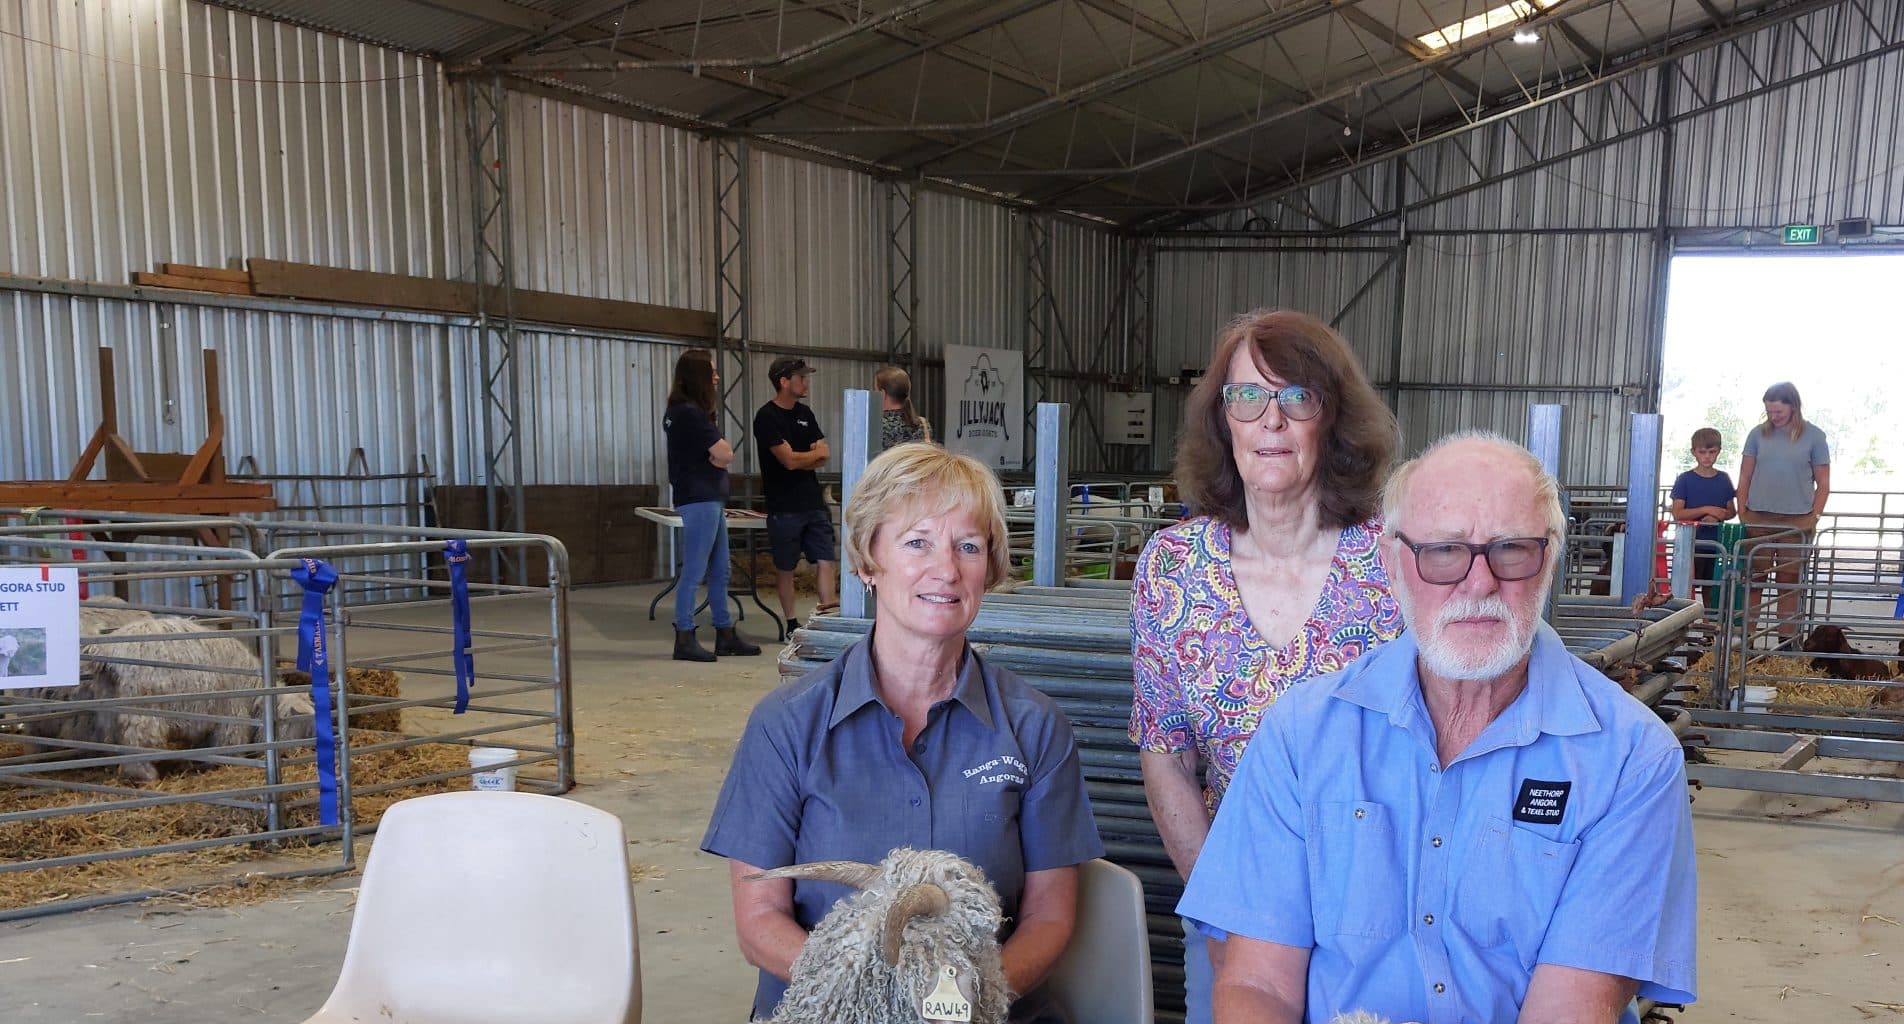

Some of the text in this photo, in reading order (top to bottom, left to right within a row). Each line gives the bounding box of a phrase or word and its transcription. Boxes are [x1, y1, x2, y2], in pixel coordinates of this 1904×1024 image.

[1790, 228, 1812, 241] EXIT
[957, 399, 1009, 441] JILLYJACK
[36, 582, 65, 592] STUD
[0, 602, 19, 612] ETT
[1529, 788, 1564, 798] NEETHORP
[1529, 798, 1557, 807] ANGORA
[1520, 806, 1527, 814] &
[1527, 808, 1544, 816] TEXEL
